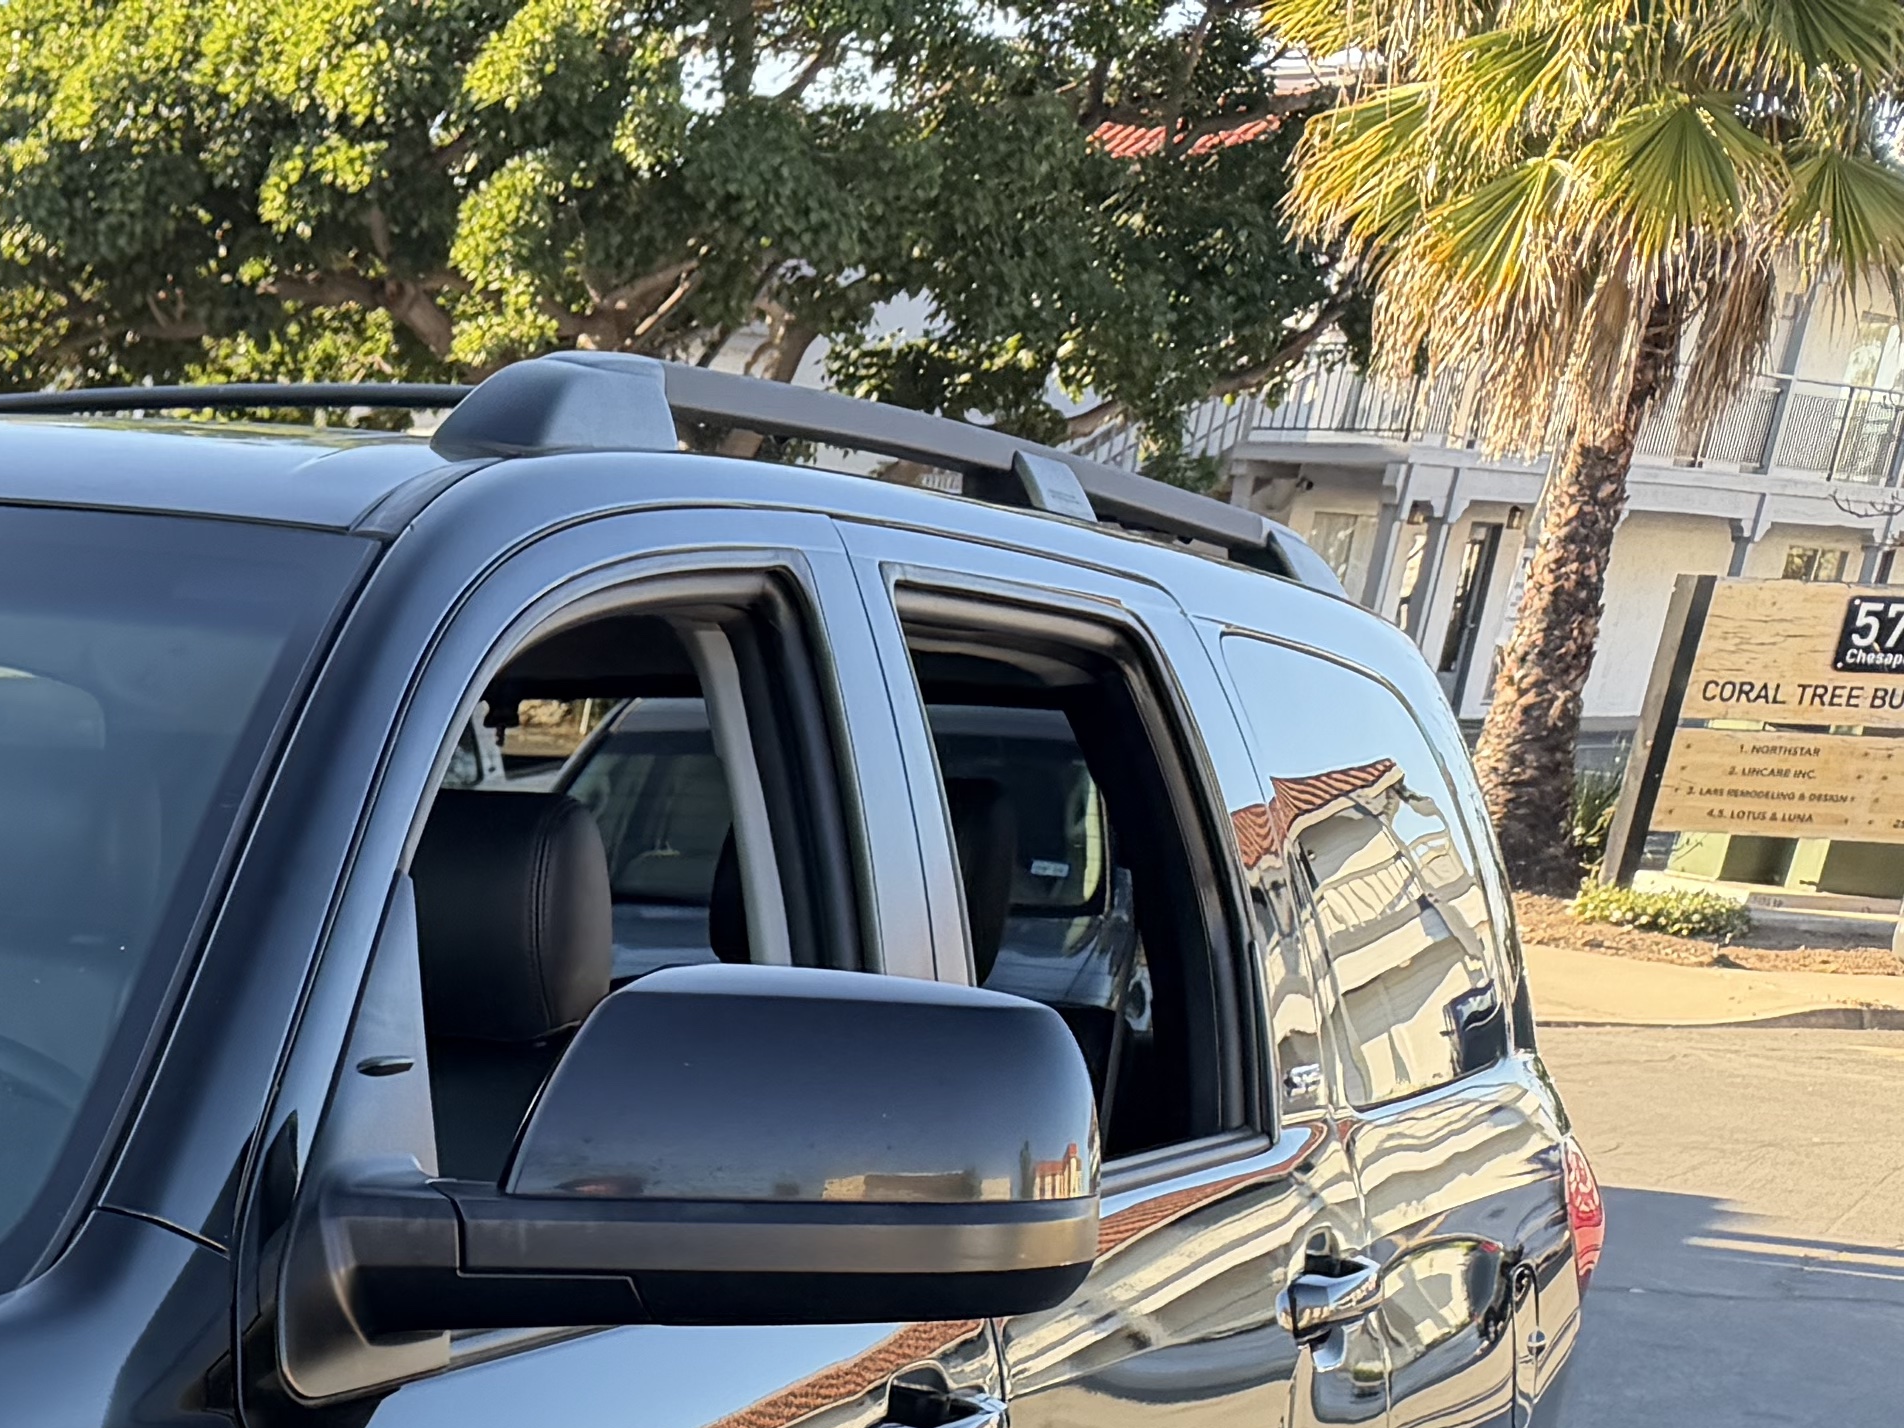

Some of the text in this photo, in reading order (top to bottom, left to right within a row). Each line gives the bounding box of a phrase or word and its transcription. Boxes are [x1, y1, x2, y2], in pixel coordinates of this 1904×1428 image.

[1852, 602, 1904, 647] 57
[1845, 648, 1904, 669] Chesap
[1702, 680, 1904, 709] CORAL TREE BU
[1750, 745, 1822, 757] NORTHSTAR
[1793, 769, 1817, 780] INC.
[1730, 809, 1767, 821] LOTUS
[1781, 813, 1814, 823] LUNA
